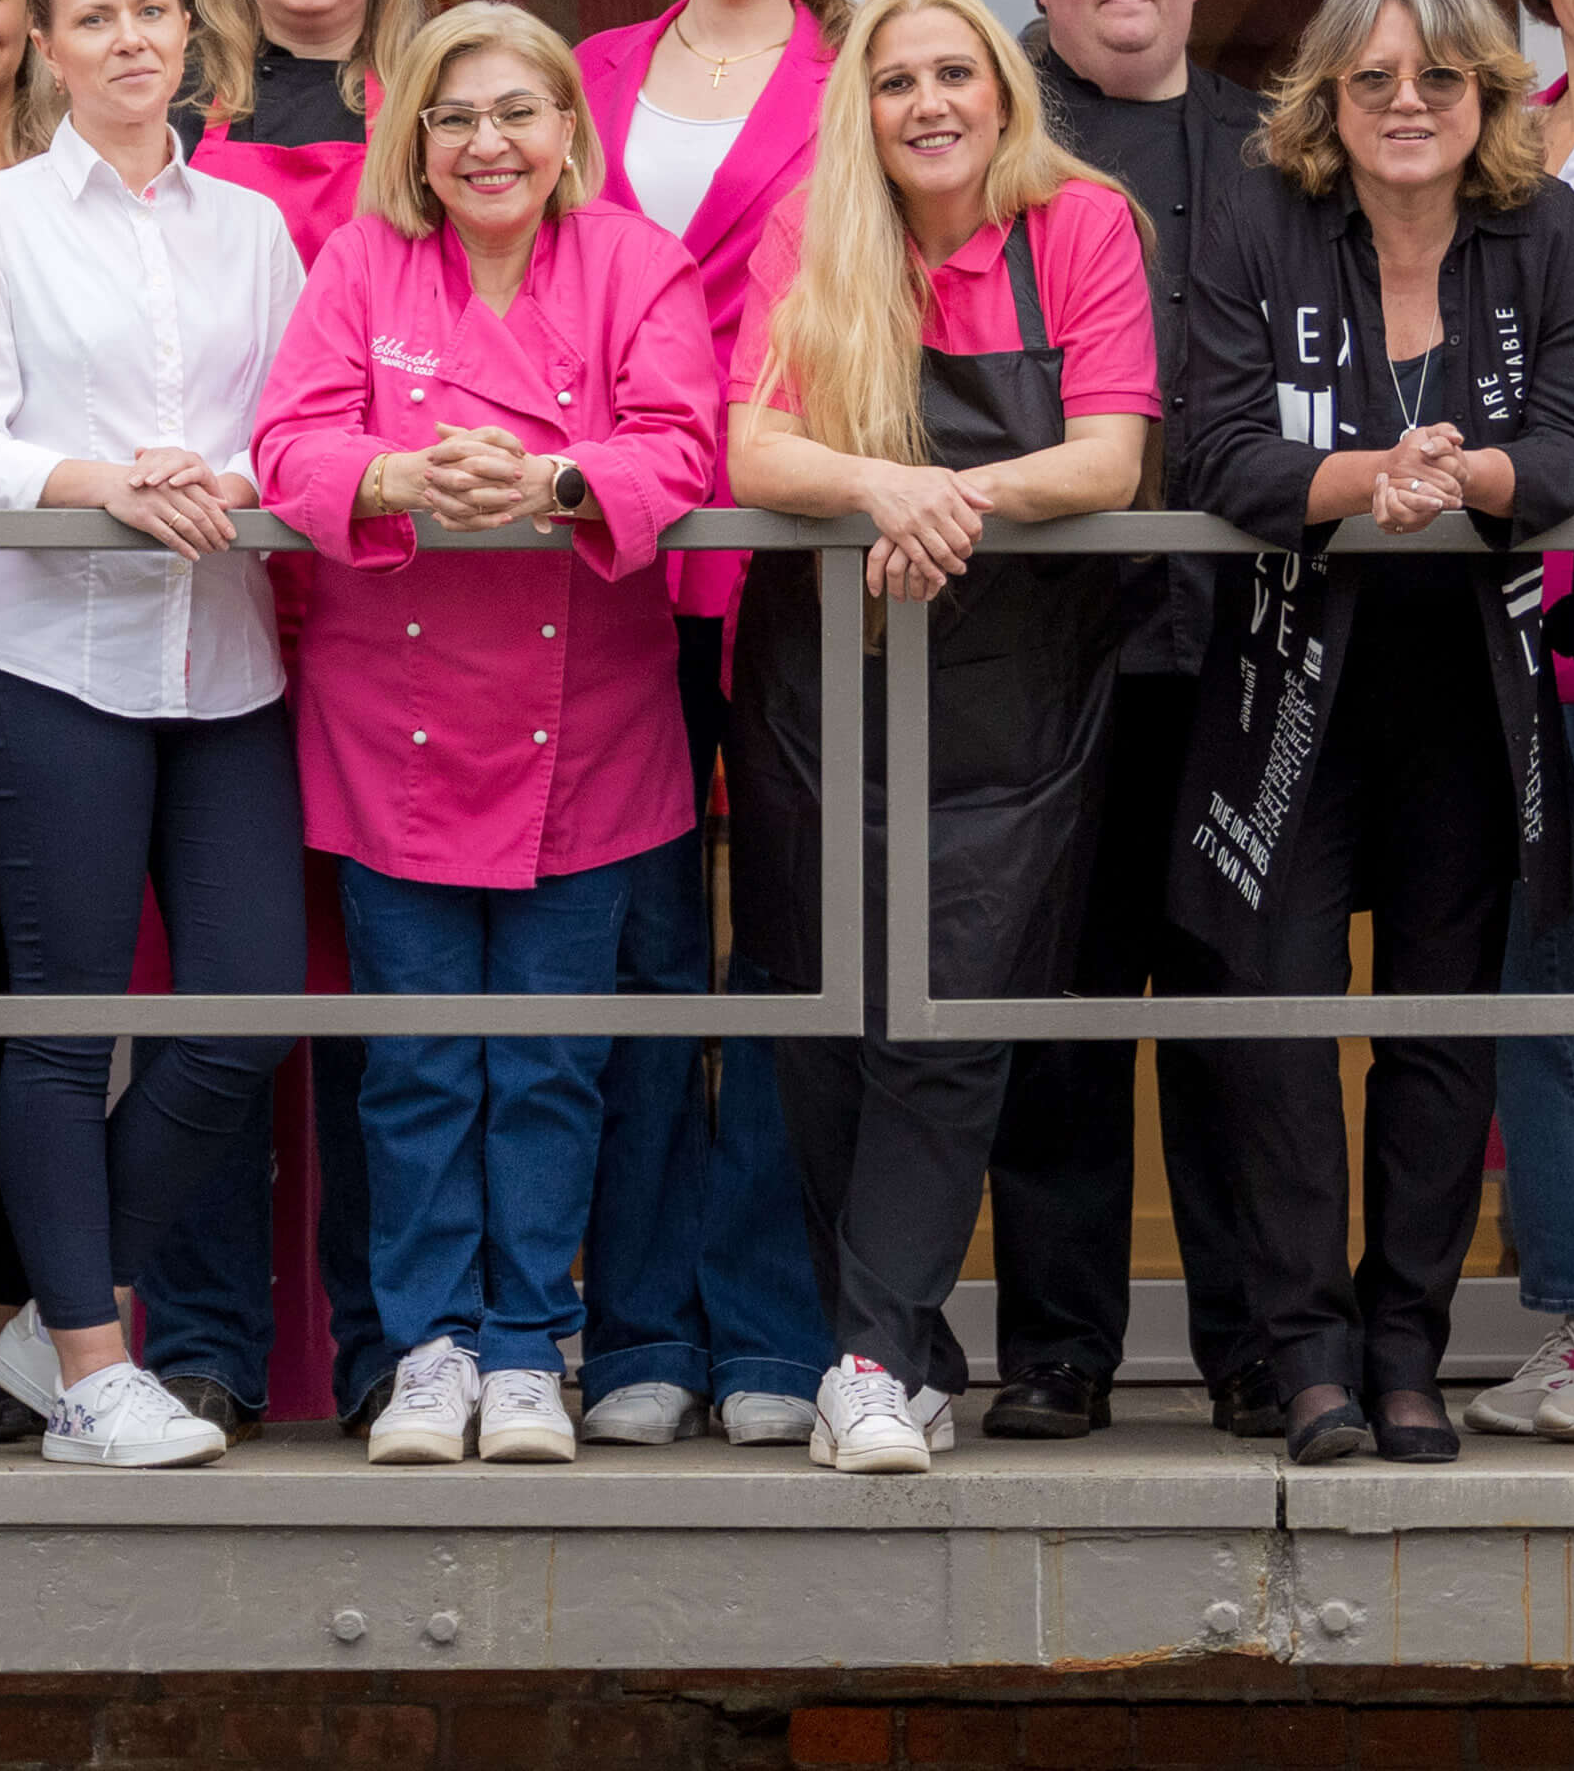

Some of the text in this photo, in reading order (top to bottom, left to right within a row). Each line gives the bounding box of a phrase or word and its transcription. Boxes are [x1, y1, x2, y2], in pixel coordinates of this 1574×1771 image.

[1477, 373, 1509, 420] ARE
[1209, 791, 1235, 830] TRUE
[1228, 815, 1252, 850] LOVE
[1216, 846, 1241, 883] OWN
